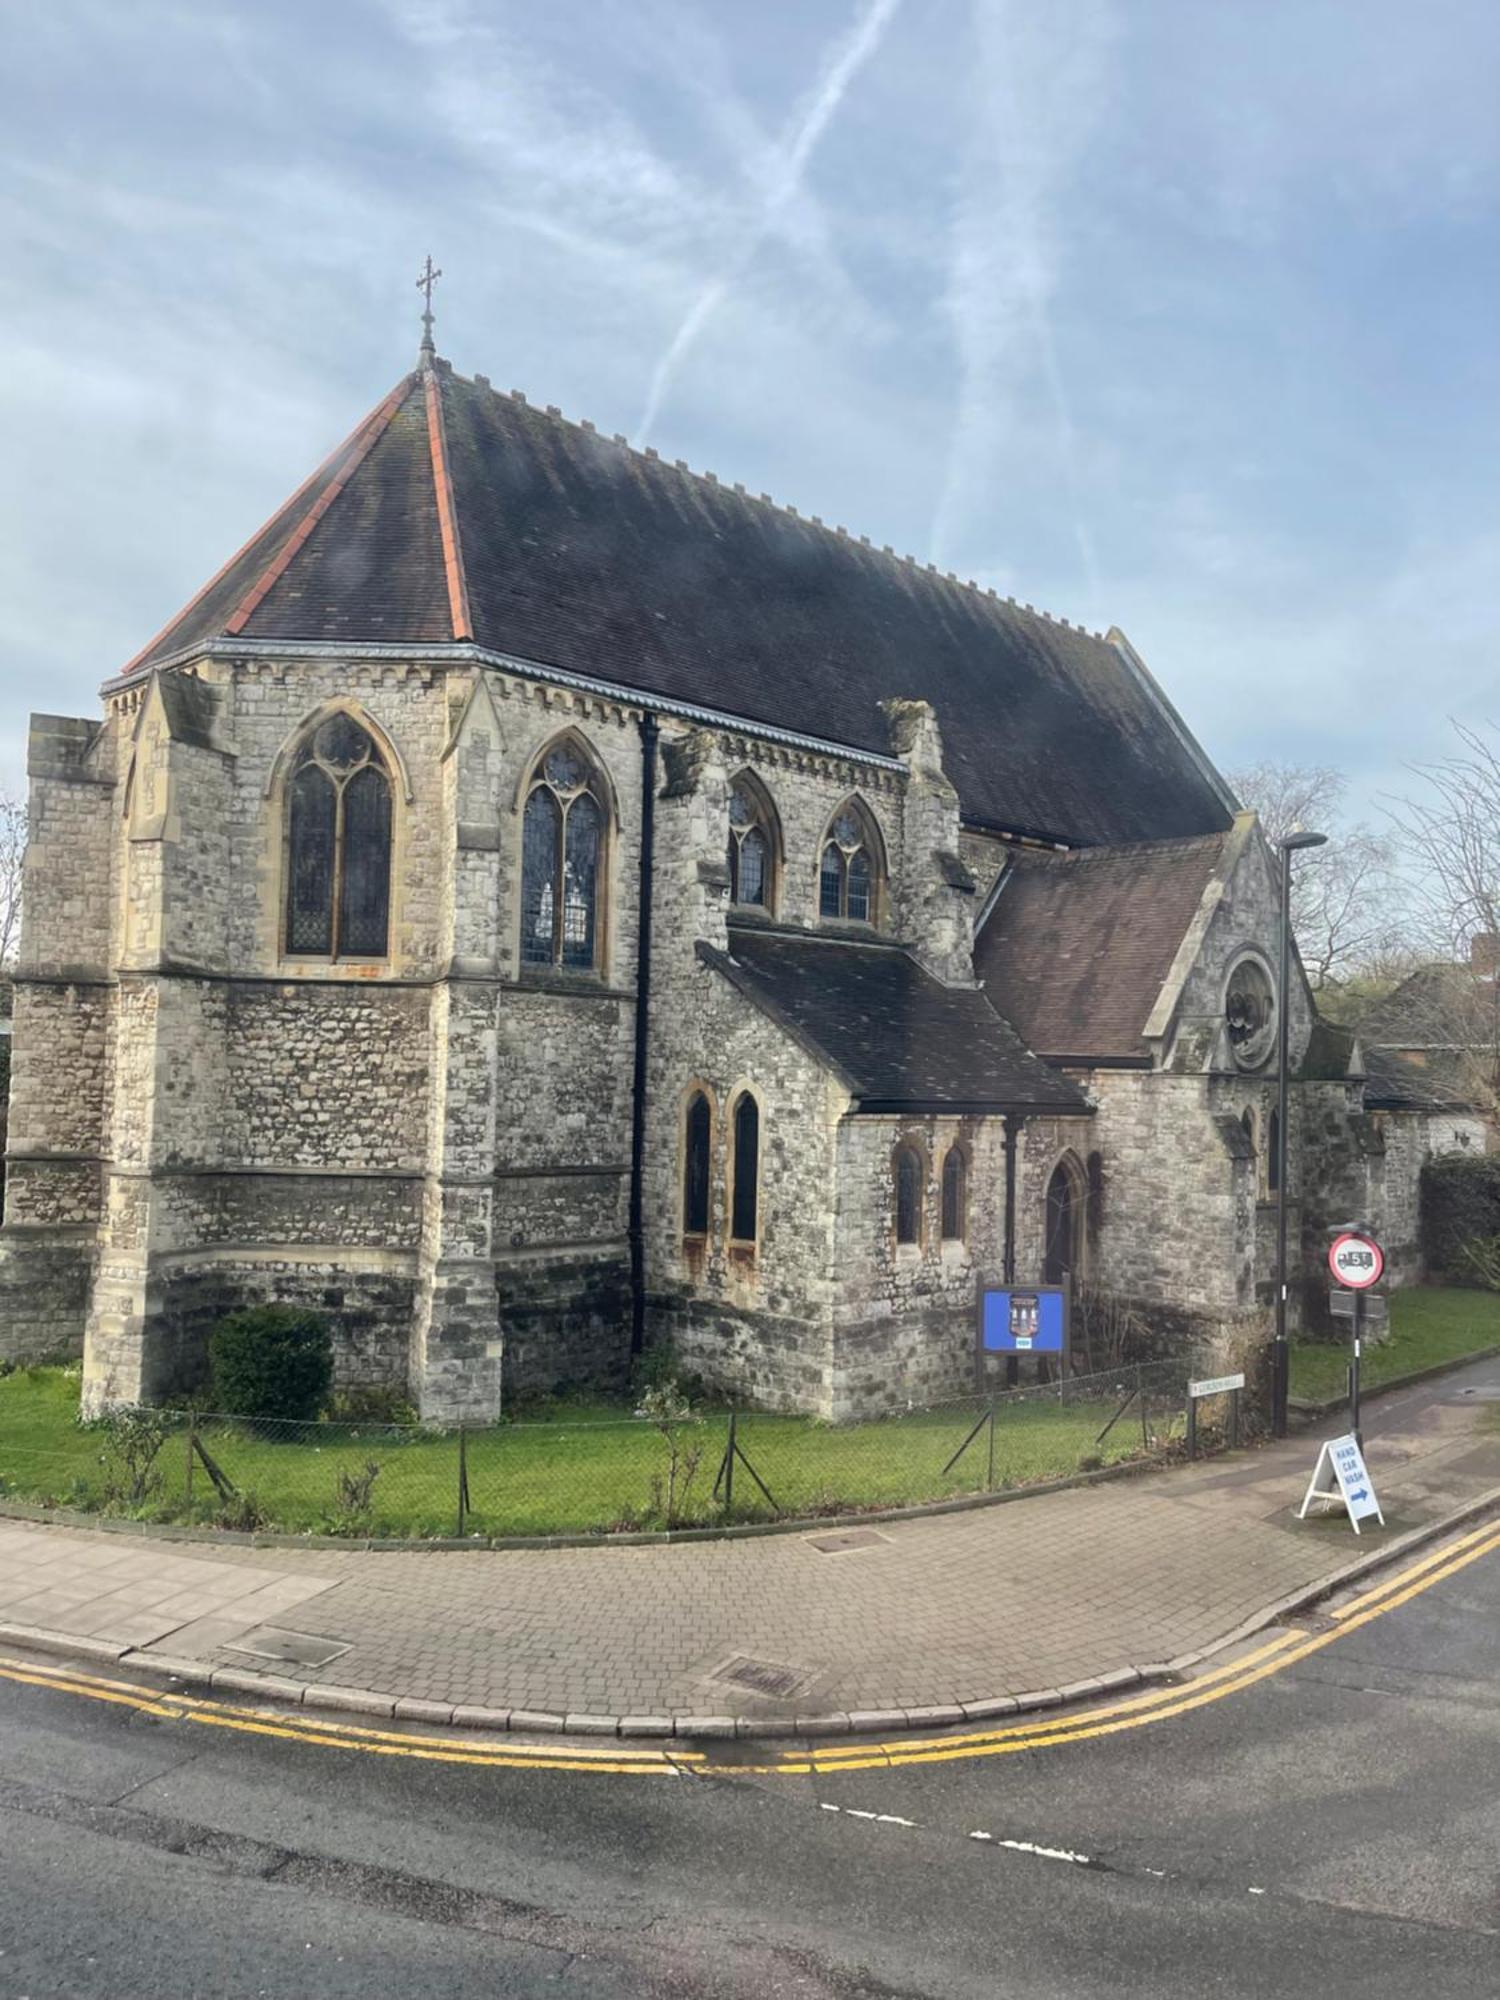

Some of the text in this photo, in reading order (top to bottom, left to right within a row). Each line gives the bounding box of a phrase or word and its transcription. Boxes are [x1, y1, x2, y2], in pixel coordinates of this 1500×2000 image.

[1337, 1446, 1355, 1458] HAND
[1343, 1459, 1357, 1472] CAR
[1344, 1471, 1364, 1484] WASH
